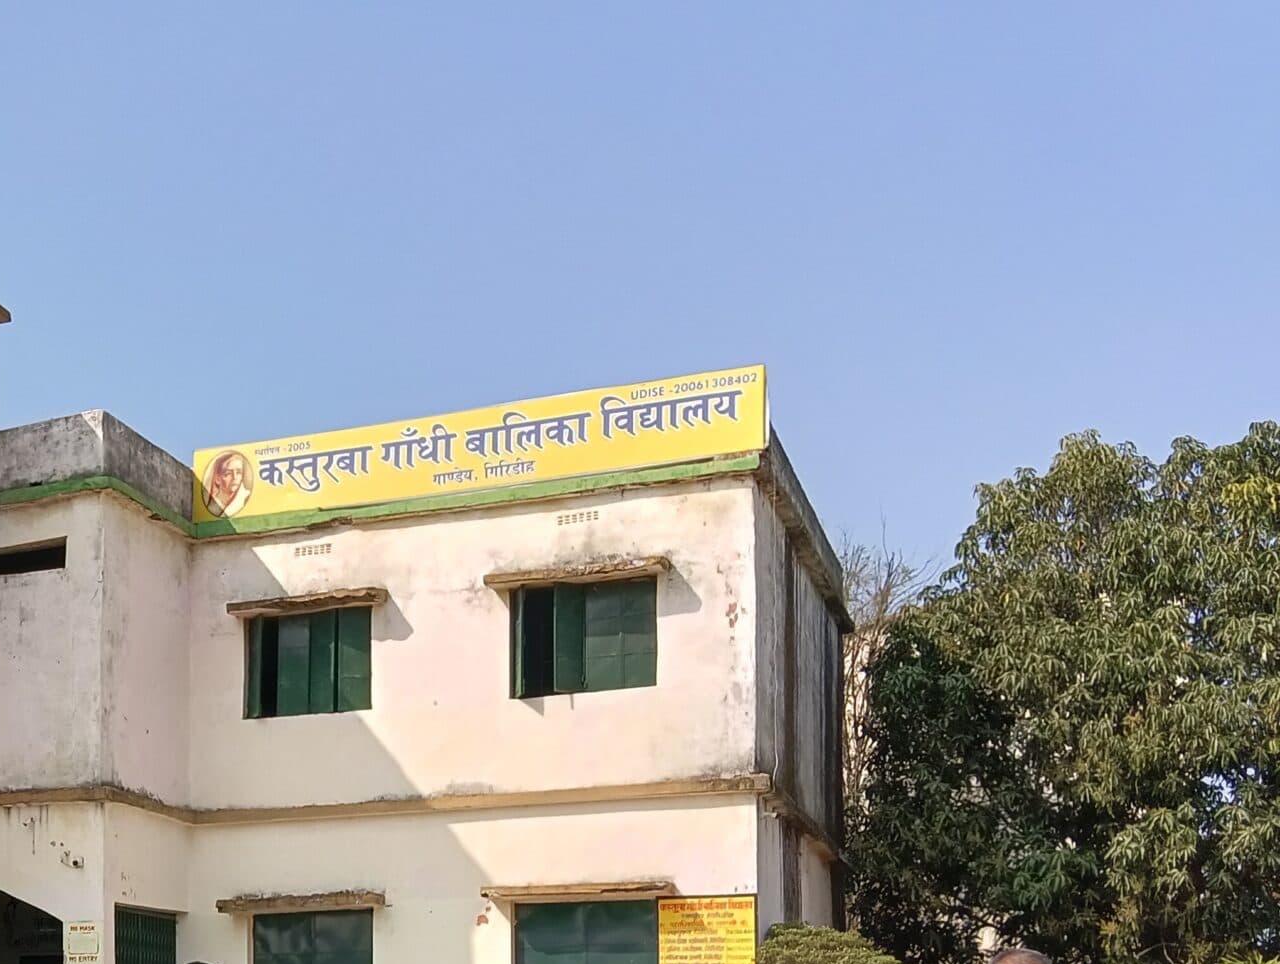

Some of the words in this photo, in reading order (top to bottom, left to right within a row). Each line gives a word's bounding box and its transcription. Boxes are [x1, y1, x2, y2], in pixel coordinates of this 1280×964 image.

[631, 387, 664, 400] UDISE
[259, 445, 373, 492] कस्तुरबा
[381, 424, 457, 469] गाँधी
[465, 411, 592, 457] बालिका
[600, 390, 743, 438] विद्यालय
[484, 457, 536, 478] गिरिडीह
